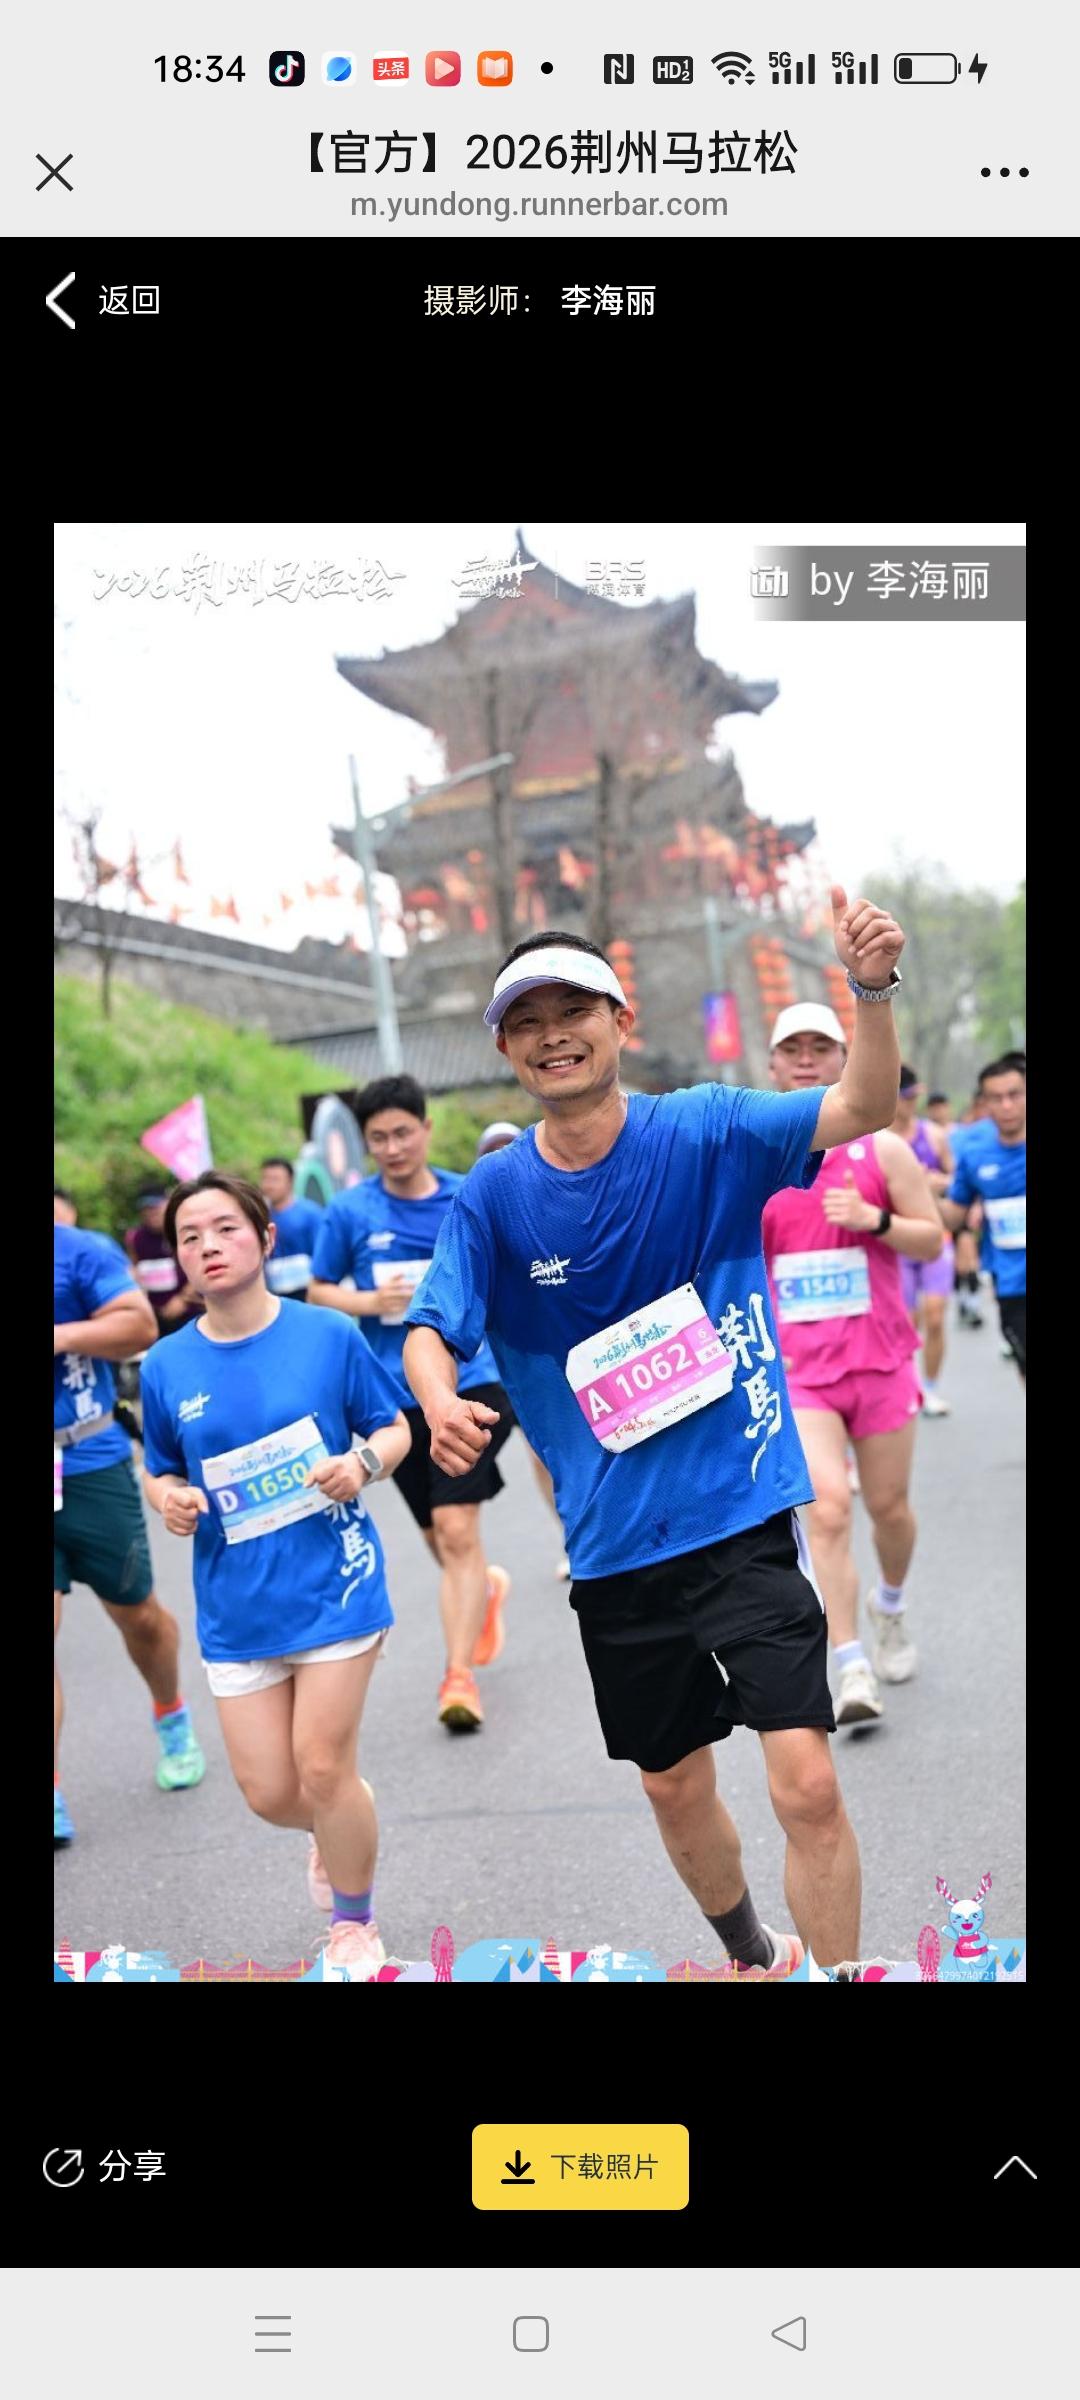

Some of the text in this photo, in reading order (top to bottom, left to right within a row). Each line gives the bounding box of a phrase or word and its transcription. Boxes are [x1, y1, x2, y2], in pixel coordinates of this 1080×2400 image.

[154, 54, 246, 83] 18:34
[377, 61, 406, 78] 头条
[768, 51, 792, 68] 5G
[831, 51, 855, 68] 5G
[351, 190, 728, 222] m.yundong.runnerbar.com
[98, 284, 160, 315] 返回
[561, 284, 657, 315] 李海丽
[587, 1387, 614, 1422] A
[615, 1342, 694, 1400] 1062
[216, 1488, 239, 1514] D
[246, 1461, 310, 1502] 1650
[98, 2148, 167, 2183] 分享
[550, 2152, 659, 2181] 下载照片
